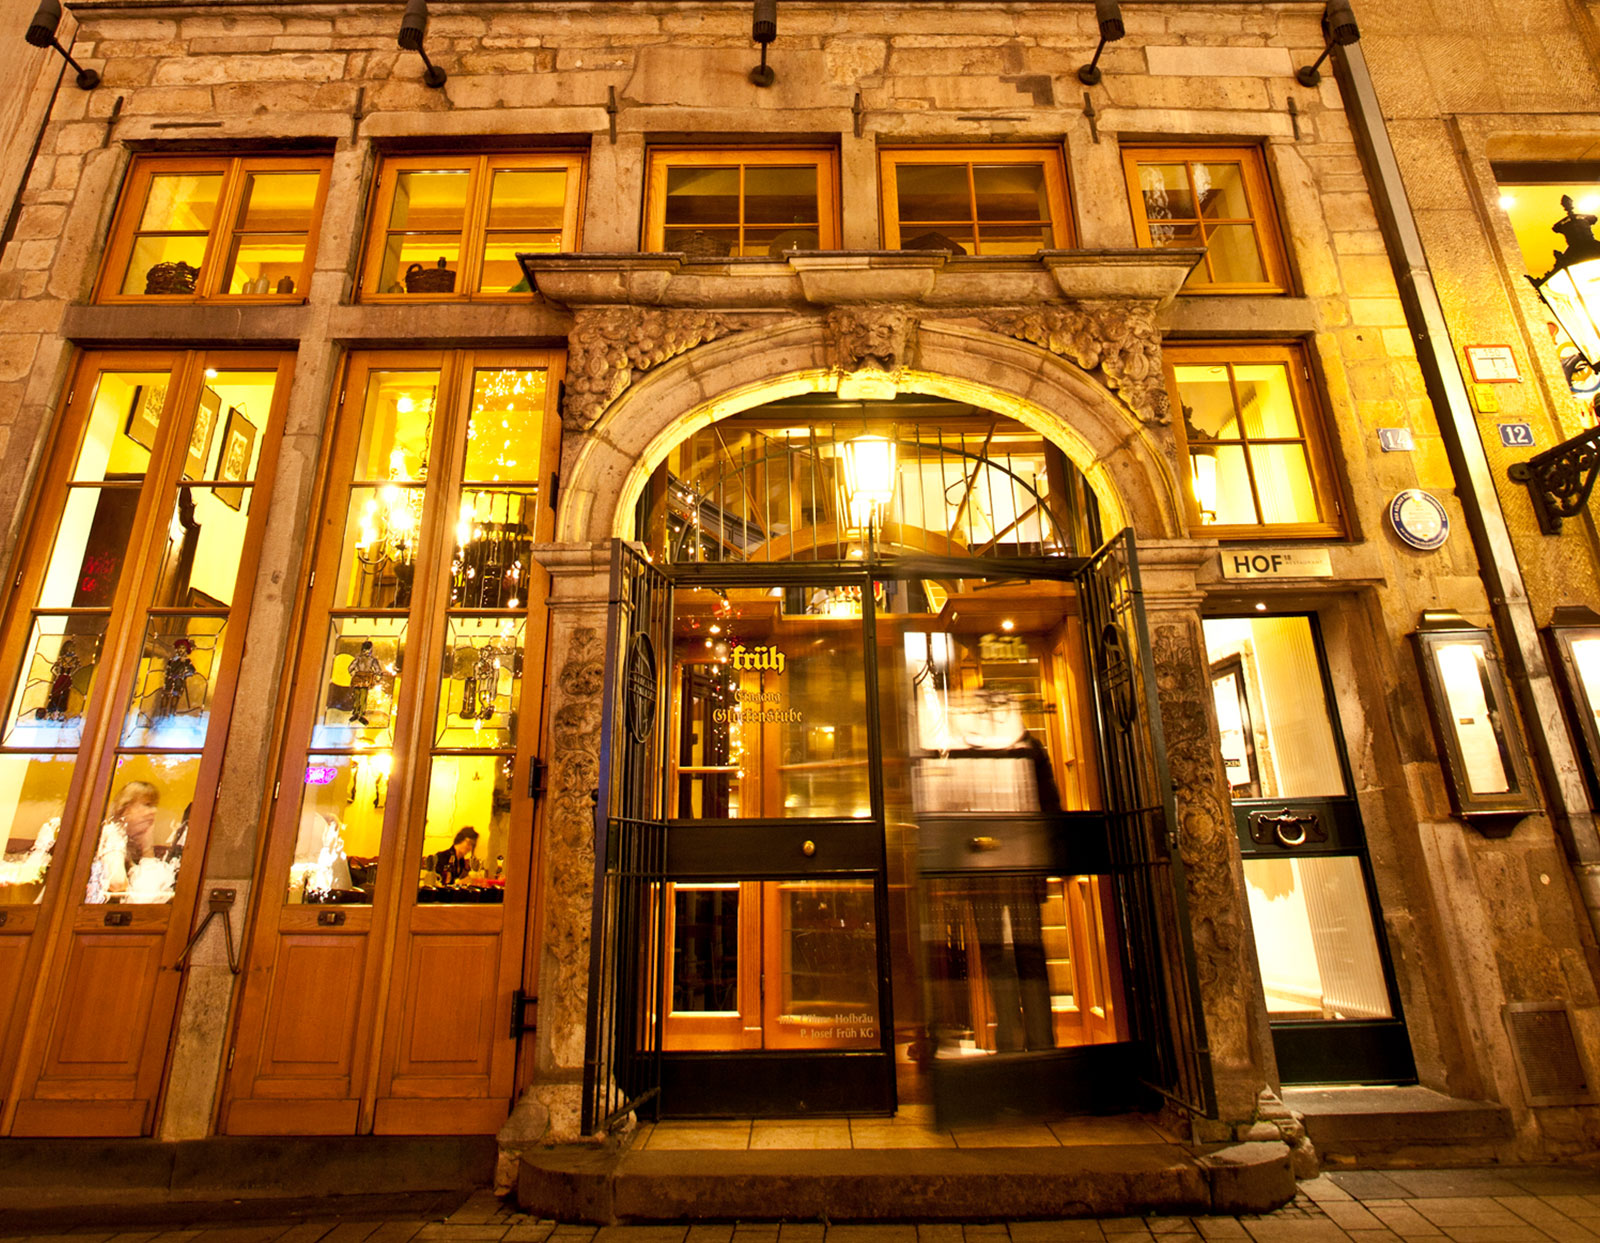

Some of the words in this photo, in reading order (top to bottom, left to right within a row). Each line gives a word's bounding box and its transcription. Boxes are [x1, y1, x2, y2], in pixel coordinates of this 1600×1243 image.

[1386, 431, 1410, 449] 14
[1506, 426, 1529, 444] 12
[1233, 555, 1283, 573] HOF
[730, 645, 786, 674] früh
[835, 1013, 873, 1023] Hofbräu
[811, 1028, 833, 1040] Josef
[837, 1028, 857, 1038] Früh
[860, 1027, 874, 1038] KG
